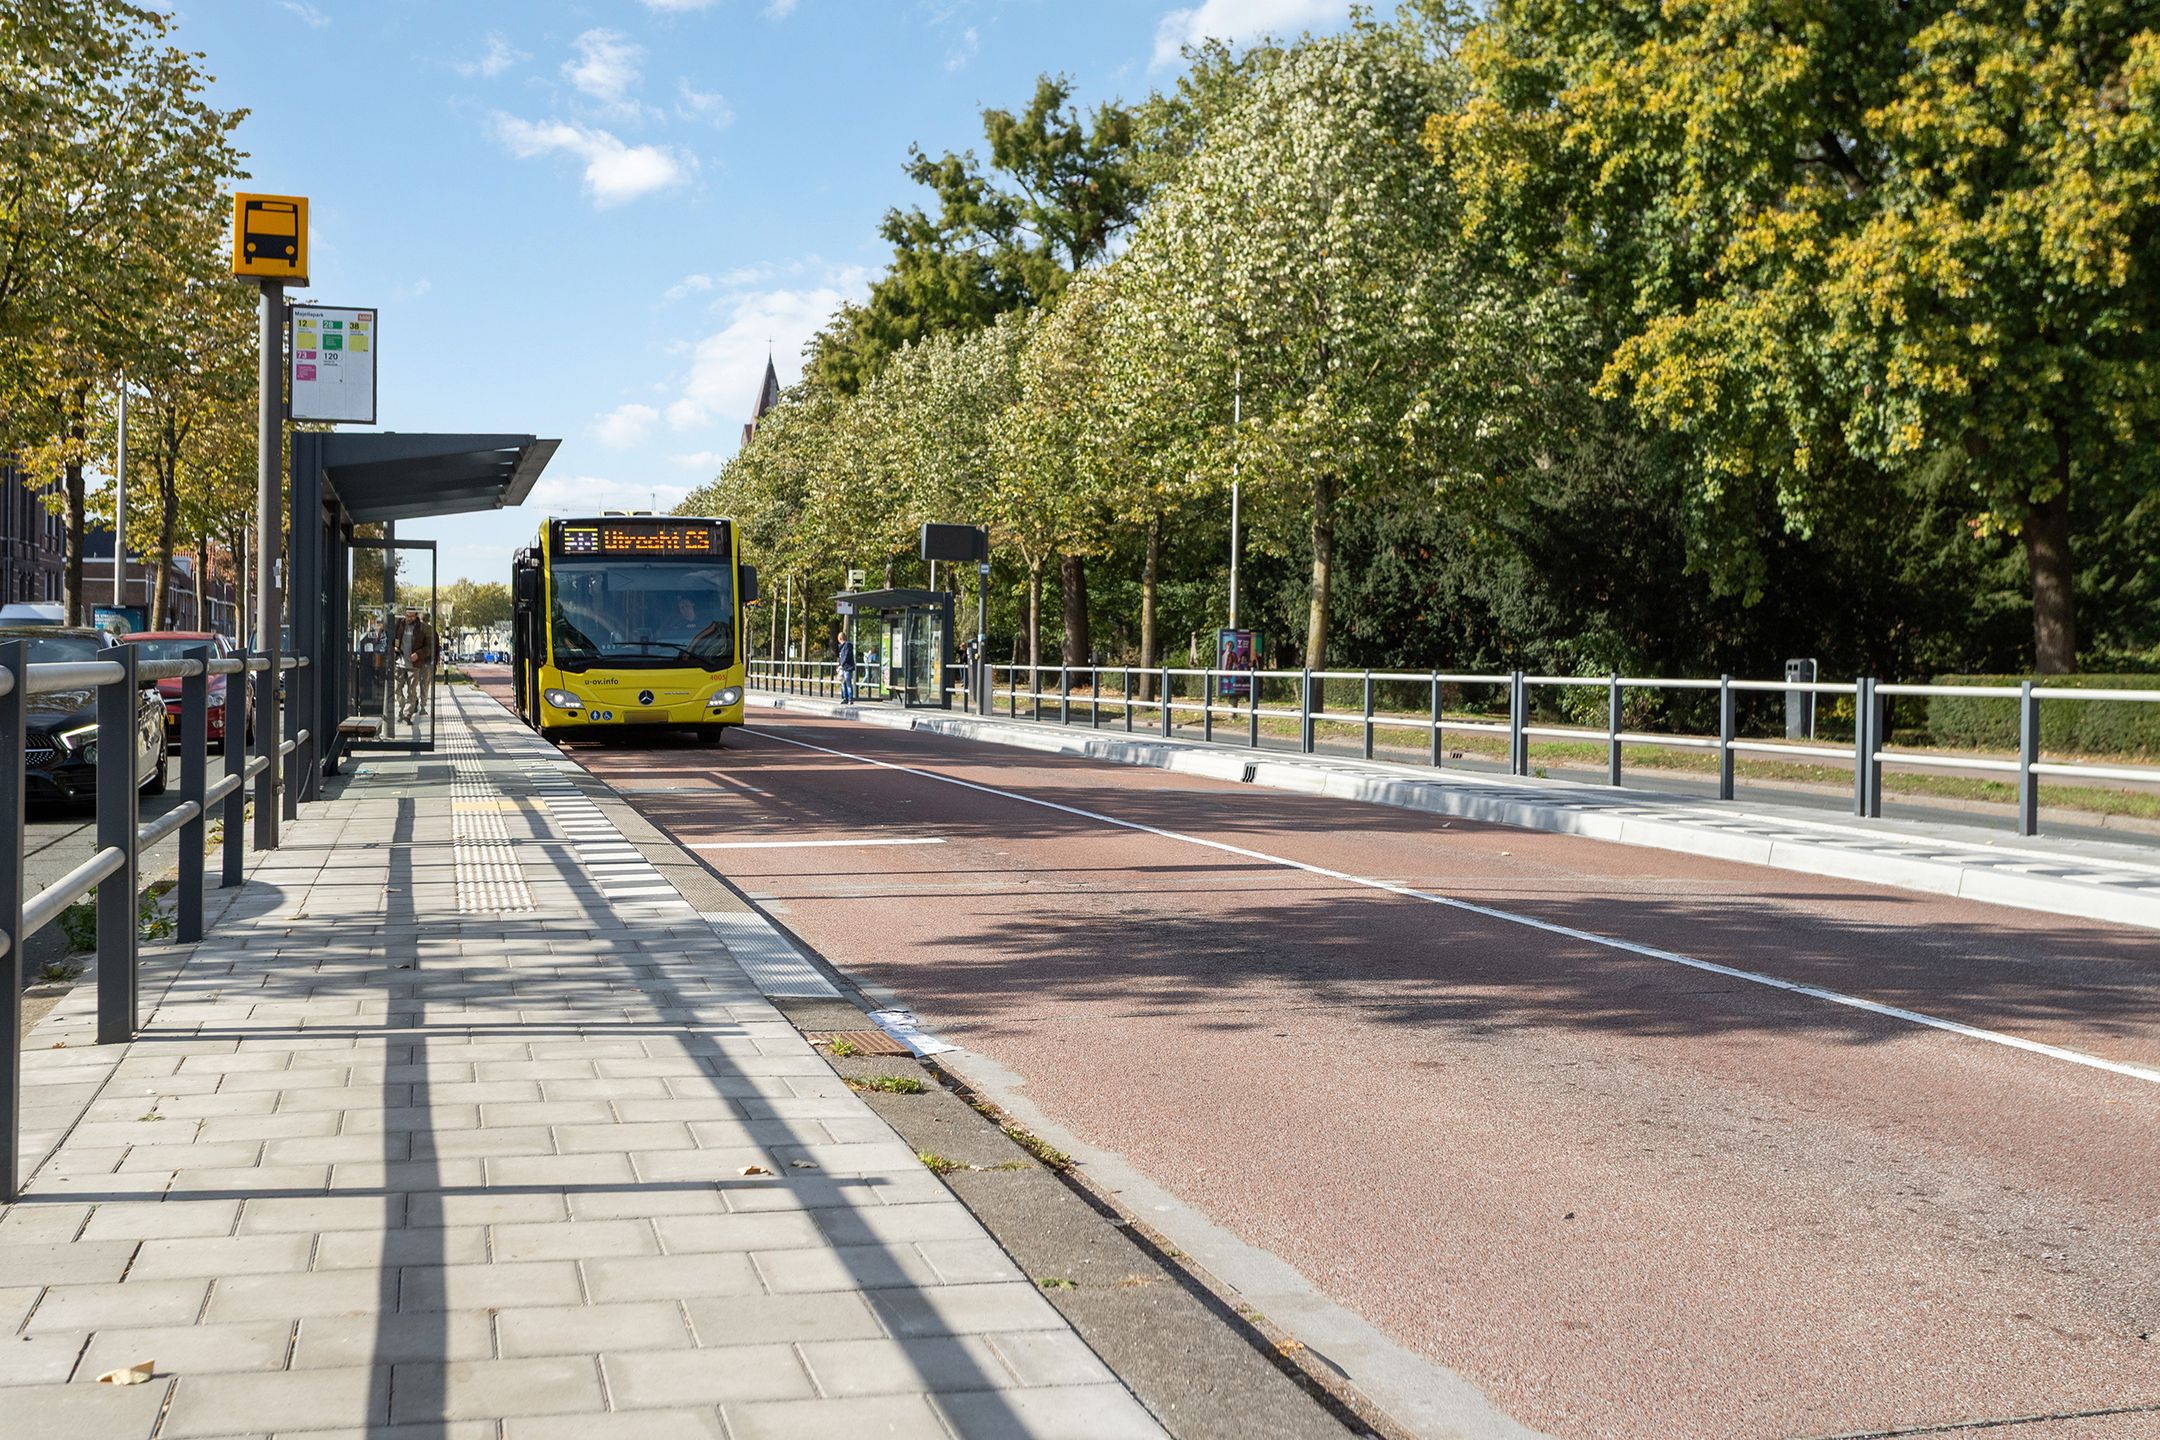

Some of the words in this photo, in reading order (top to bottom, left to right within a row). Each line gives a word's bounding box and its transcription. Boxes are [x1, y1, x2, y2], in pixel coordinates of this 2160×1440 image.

[298, 320, 308, 328] 12
[324, 352, 338, 360] 120
[604, 530, 680, 549] Utrecht
[685, 529, 710, 549] CS
[584, 677, 619, 685] u-ov.info
